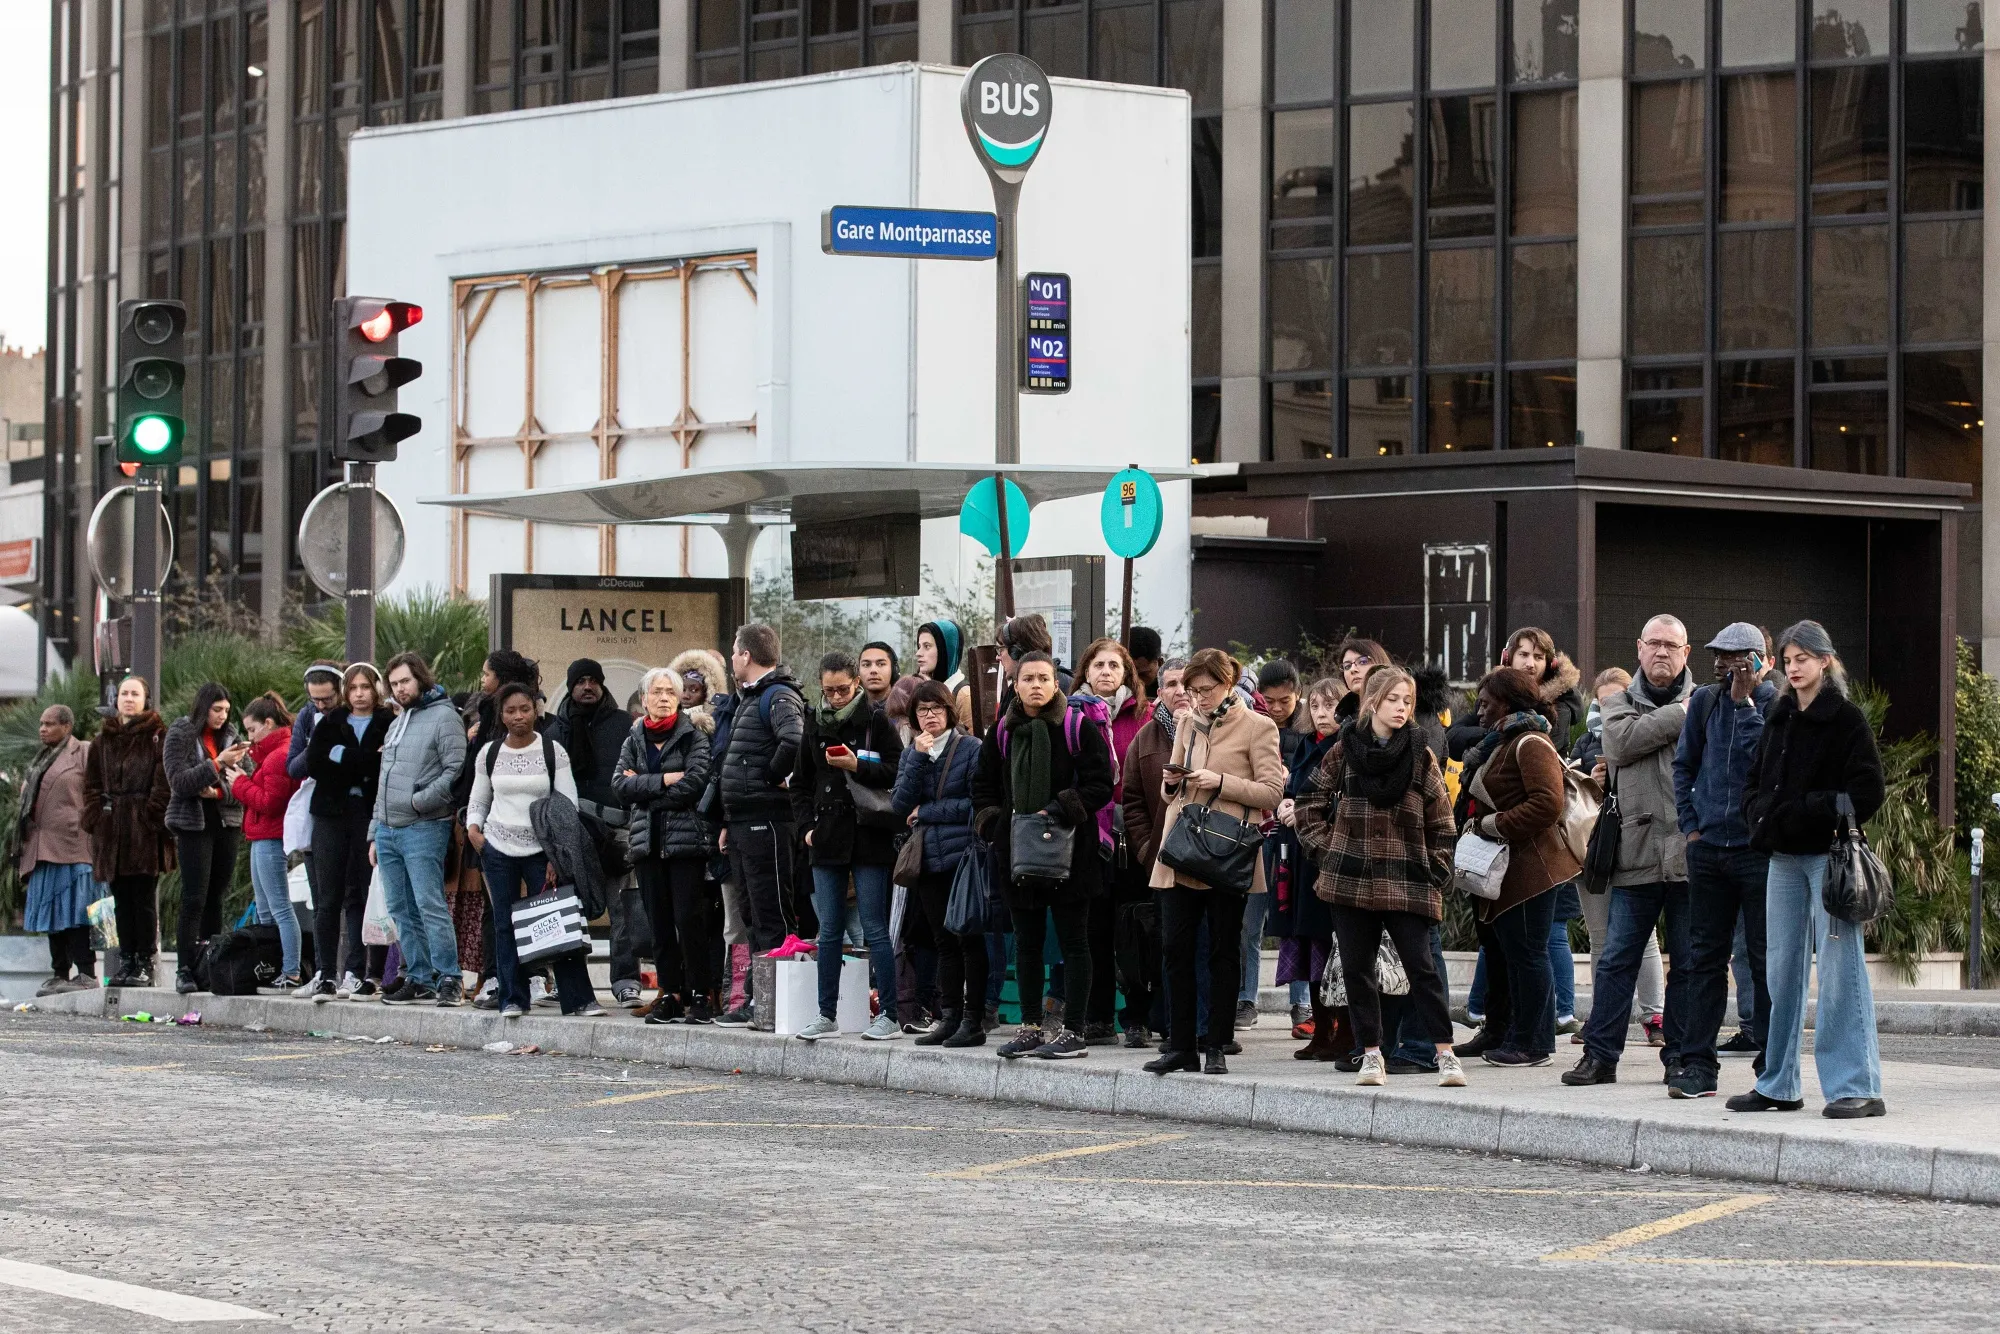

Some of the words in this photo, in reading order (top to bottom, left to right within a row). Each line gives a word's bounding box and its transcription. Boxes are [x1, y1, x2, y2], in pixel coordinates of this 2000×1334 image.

[981, 81, 1040, 116] BUS
[837, 220, 874, 240] Gare
[879, 222, 992, 246] Montparnasse
[1122, 483, 1135, 496] 96
[598, 578, 645, 588] JCDecaux
[560, 607, 673, 633] LANCEL
[596, 636, 618, 644] PARIS
[529, 896, 558, 907] SEPHORA
[533, 922, 560, 938] COLLECT
